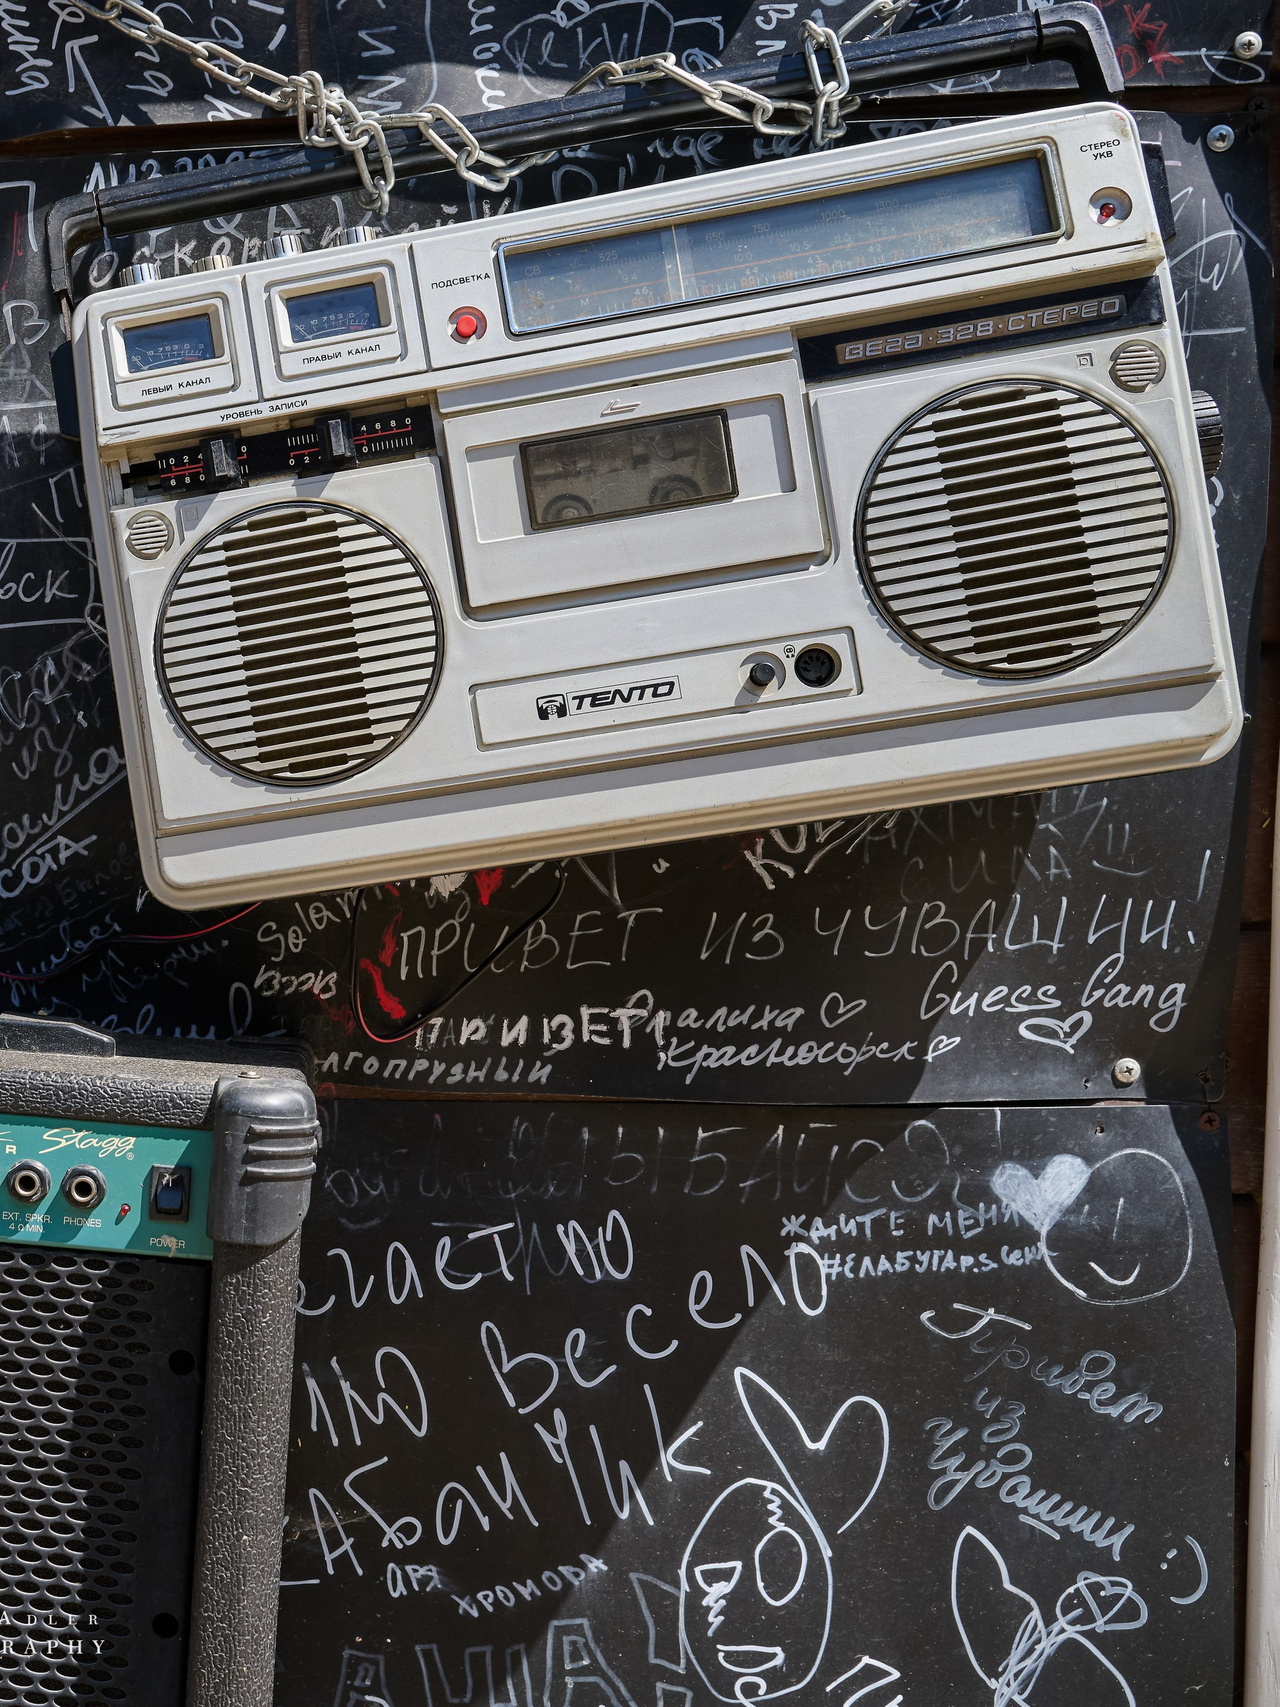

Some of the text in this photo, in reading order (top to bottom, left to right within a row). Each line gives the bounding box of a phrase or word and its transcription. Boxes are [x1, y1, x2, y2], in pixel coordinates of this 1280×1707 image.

[1079, 139, 1121, 153] СТЕРЕО
[1092, 150, 1114, 161] УКВ
[598, 251, 618, 263] 525
[705, 231, 725, 243] 650
[752, 222, 771, 234] 750
[821, 208, 845, 221] 1000
[876, 198, 899, 210] 1300
[431, 272, 491, 290] ПОДСВЕТКА
[302, 343, 381, 365] ПРАВЫЙ КАНАЛ
[141, 377, 211, 397] ЛЕВЫЙ КАНАЛ
[220, 399, 308, 422] УРОВЕНЬ ЗАПИСИ
[571, 680, 676, 711] TENTO
[400, 906, 664, 982] ПРИВЕТ
[701, 909, 786, 964] ИЗ
[919, 953, 1188, 1033] Guess Gang
[5, 1143, 17, 1155] R
[38, 1127, 137, 1158] Stagg
[2, 1211, 53, 1224] EXT. SPKR.
[63, 1216, 102, 1229] PHONES
[8, 1223, 16, 1231] 4
[26, 1223, 45, 1234] MIN.
[149, 1237, 186, 1250] POWER
